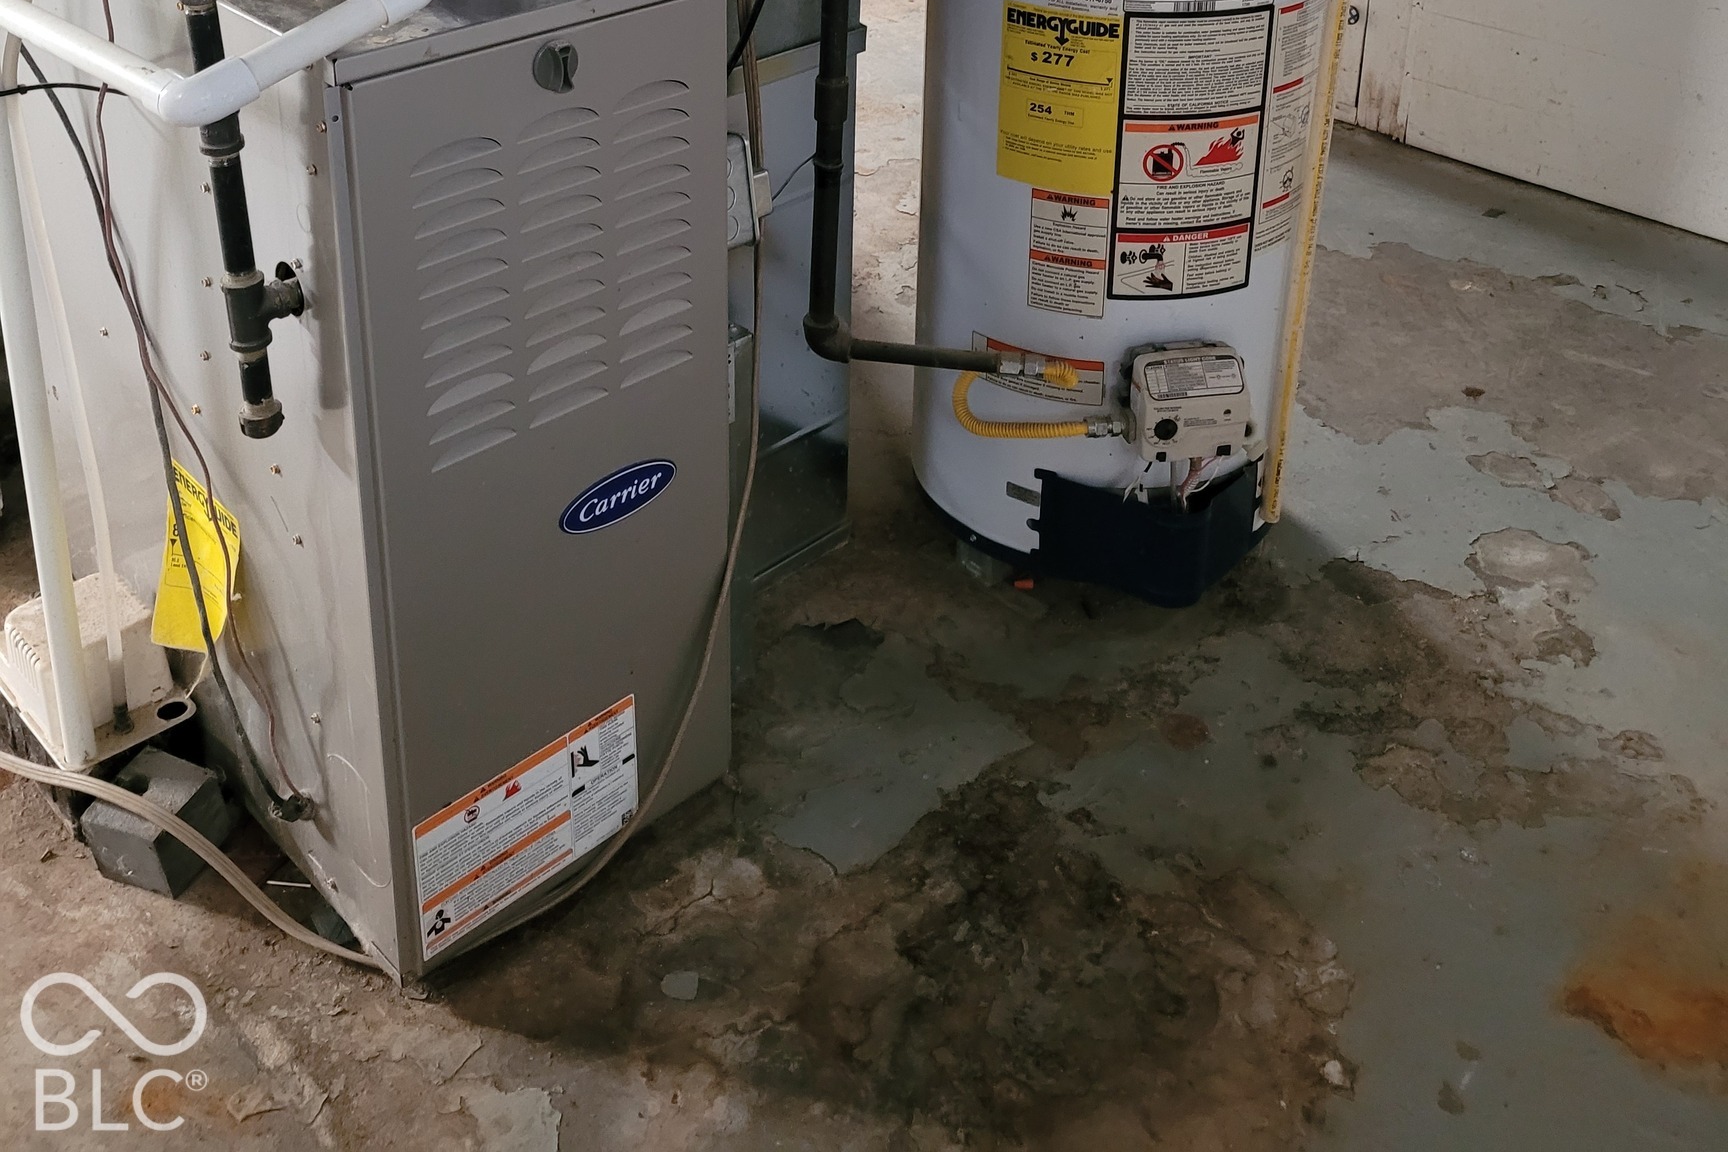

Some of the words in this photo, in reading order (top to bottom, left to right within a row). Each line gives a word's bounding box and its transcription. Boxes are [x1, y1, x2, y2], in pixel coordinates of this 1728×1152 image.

[1007, 7, 1120, 39] ENERGYGUIDE
[1025, 39, 1046, 48] Estimated
[1062, 46, 1079, 54] Energy
[1031, 51, 1038, 62] $
[1042, 51, 1074, 67] 277
[1029, 102, 1052, 115] 254
[1176, 122, 1219, 131] WARNING
[1028, 136, 1045, 145] depend
[1054, 193, 1096, 206] WARNING
[1172, 232, 1209, 242] DANGER
[1051, 256, 1093, 267] WARNING
[173, 466, 238, 539] ENERGYUIDE
[580, 472, 662, 522] Carrier
[590, 765, 618, 785] OPERATION
